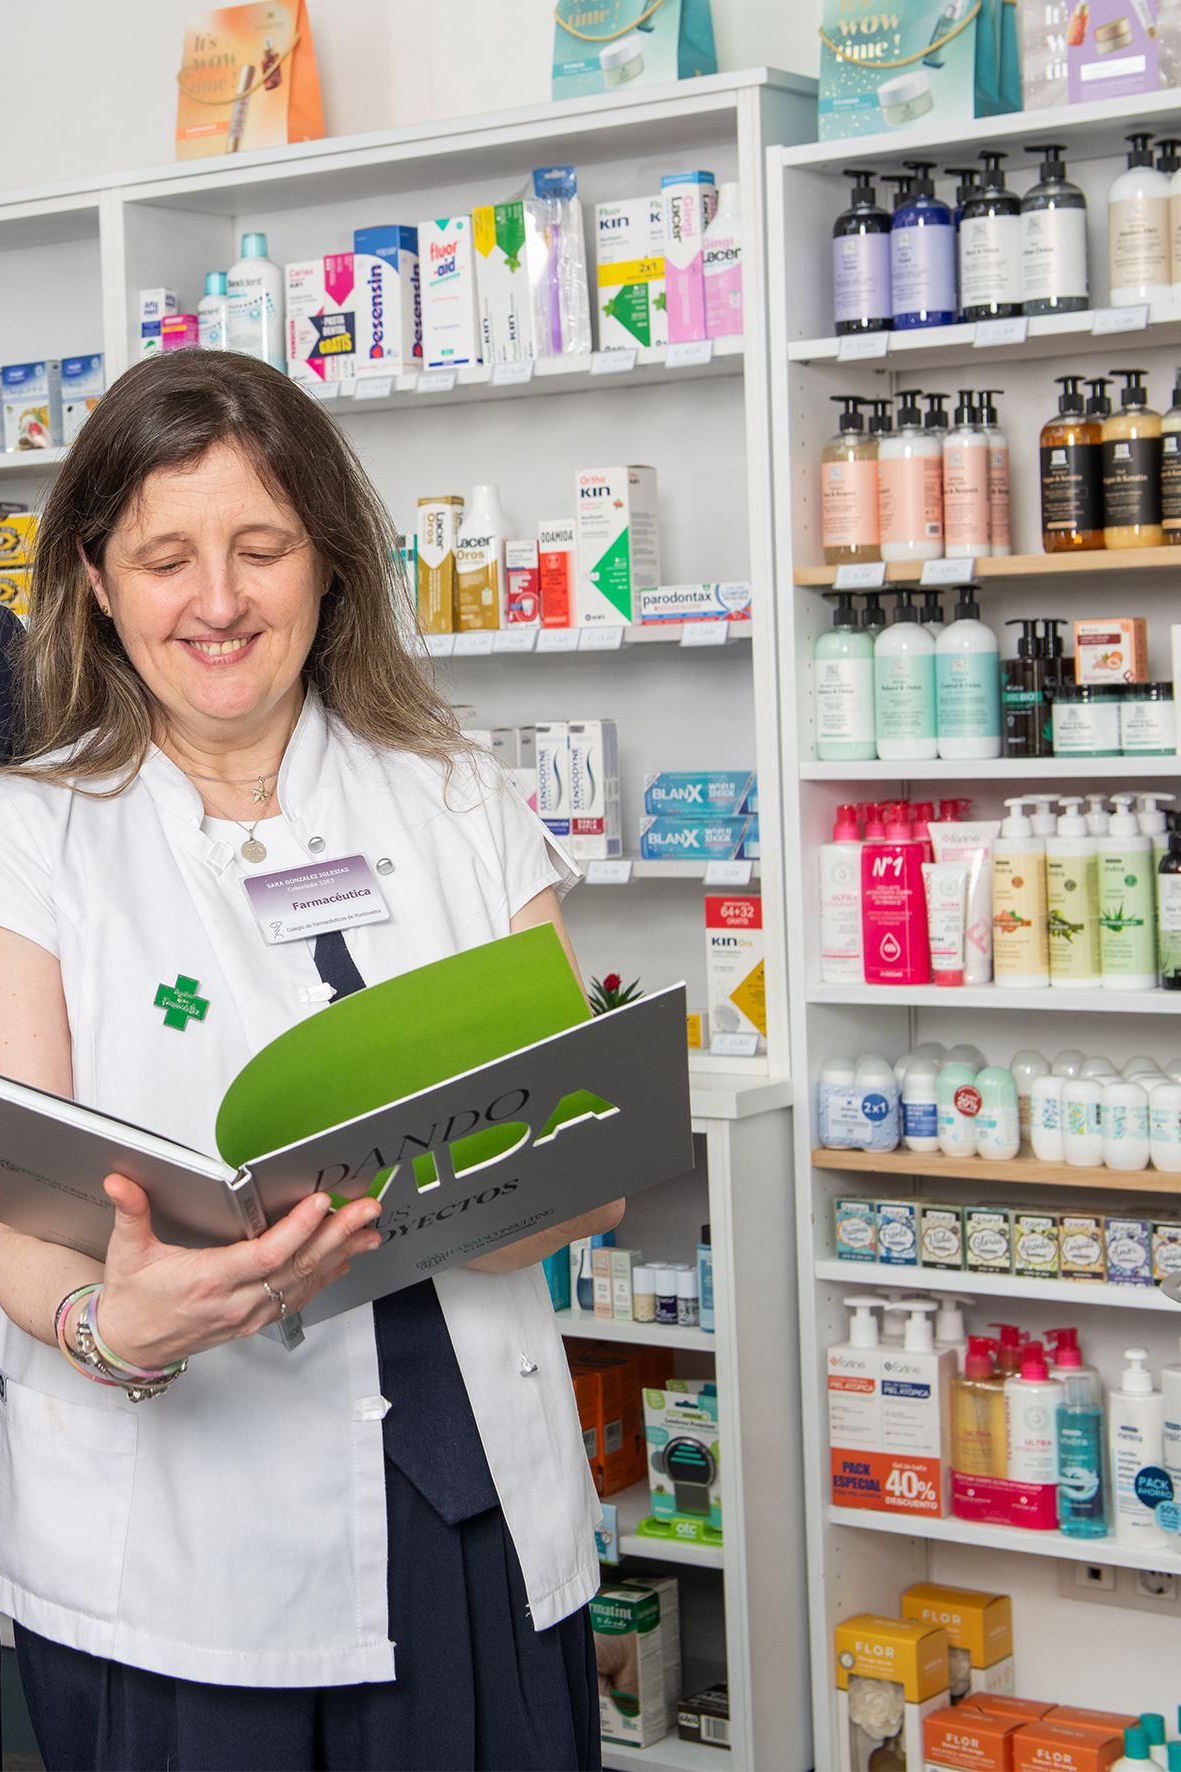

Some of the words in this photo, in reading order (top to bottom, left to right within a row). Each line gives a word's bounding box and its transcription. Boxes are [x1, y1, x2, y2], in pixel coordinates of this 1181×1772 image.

[367, 265, 384, 359] Desensin
[643, 591, 712, 609] parodontax
[319, 867, 349, 879] IGLESIAS
[292, 887, 371, 911] Farmacéutica
[863, 1102, 886, 1114] 2x1
[314, 1088, 531, 1192] DANDO
[842, 1461, 871, 1476] PACK
[833, 1475, 882, 1492] ESPECIAL
[885, 1470, 936, 1500] 40%
[1138, 1477, 1169, 1489] PACK
[885, 1496, 938, 1511] DESCUENTO
[922, 1609, 962, 1625] FLOR
[855, 1641, 895, 1657] FLOR
[946, 1733, 979, 1747] FLOR
[1037, 1748, 1072, 1763] FLOR
